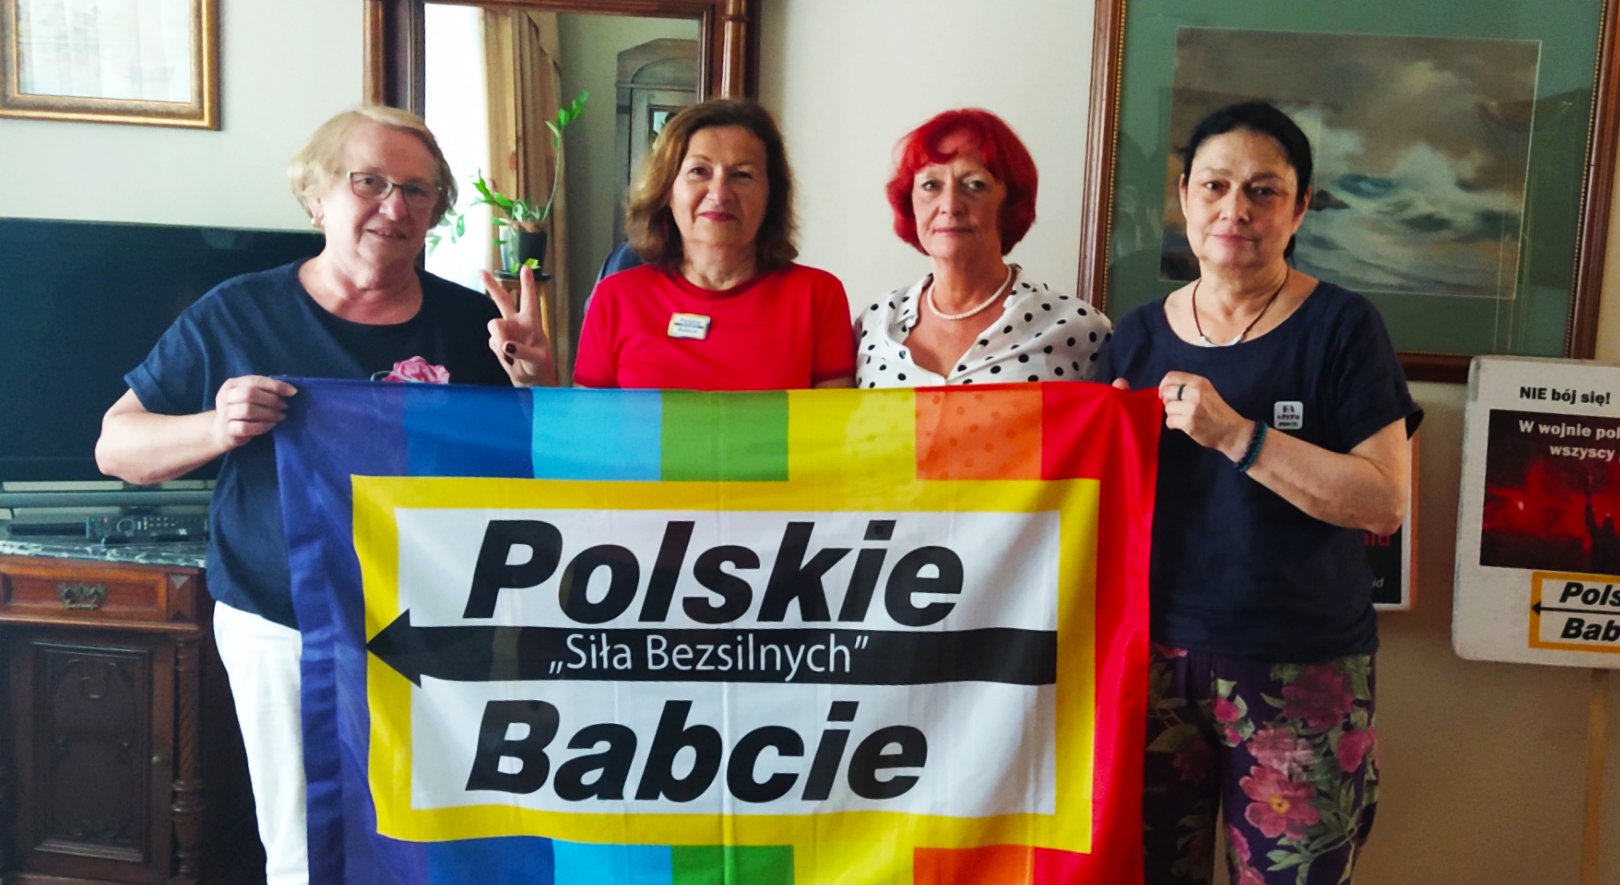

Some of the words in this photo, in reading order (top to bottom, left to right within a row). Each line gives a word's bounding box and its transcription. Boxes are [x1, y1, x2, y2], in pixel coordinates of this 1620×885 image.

[1520, 386, 1548, 400] NIE
[1551, 388, 1577, 405] bój
[1580, 390, 1611, 407] się!
[1519, 419, 1534, 433] W
[1538, 422, 1592, 438] wojnie
[1549, 445, 1615, 462] wszyscy
[463, 520, 964, 627] Polskie
[548, 633, 632, 674] „Siła
[466, 700, 928, 803] Babcie
